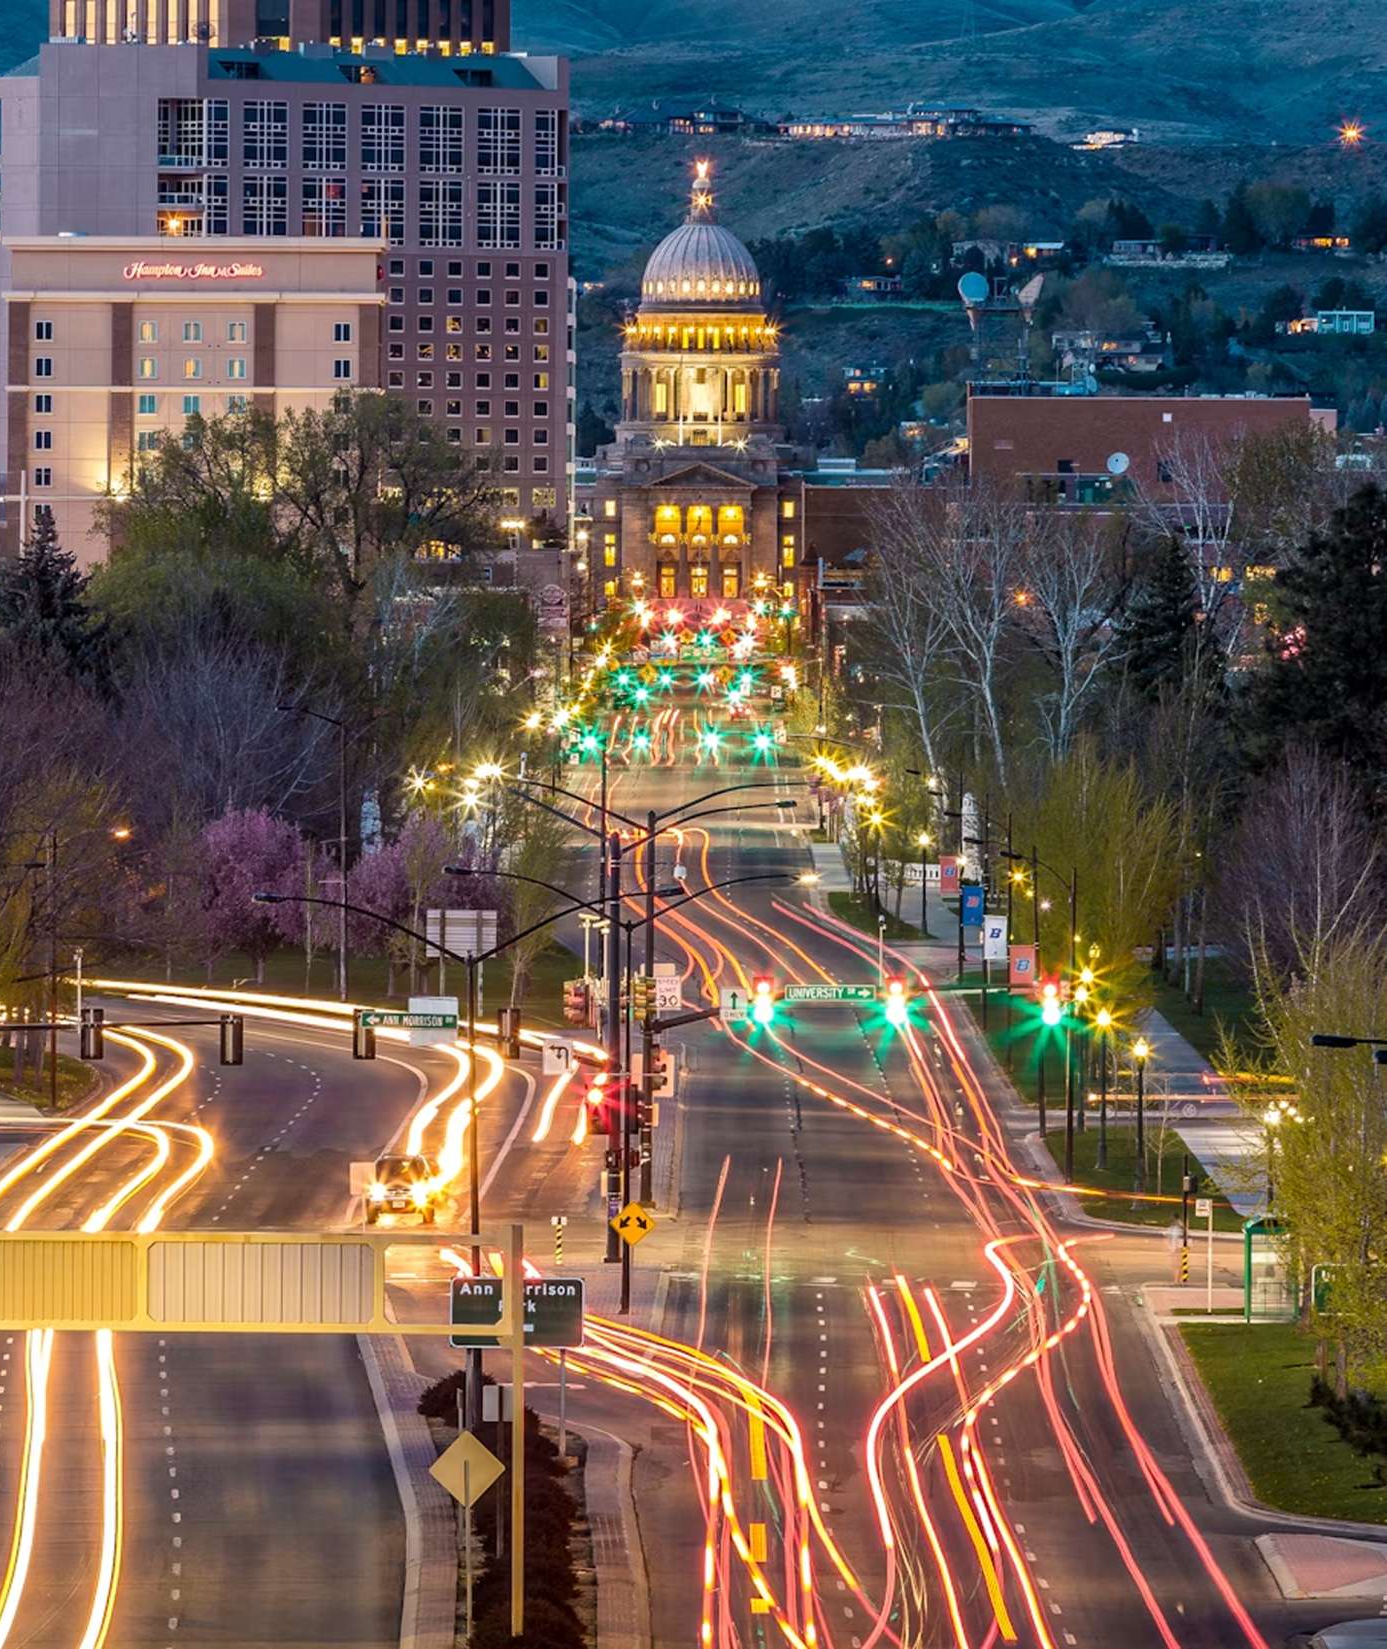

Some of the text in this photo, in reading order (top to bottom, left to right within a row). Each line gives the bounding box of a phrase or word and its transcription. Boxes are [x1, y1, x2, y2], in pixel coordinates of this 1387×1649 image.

[123, 262, 187, 278] Hampton
[188, 263, 221, 278] Inn
[228, 263, 263, 277] Suites
[989, 928, 1002, 939] B
[788, 986, 844, 999] UNIVERSITY
[658, 994, 679, 1008] 30
[383, 1015, 400, 1025] ANN
[402, 1014, 443, 1026] MORRISON
[460, 1282, 576, 1297] Ann rrison
